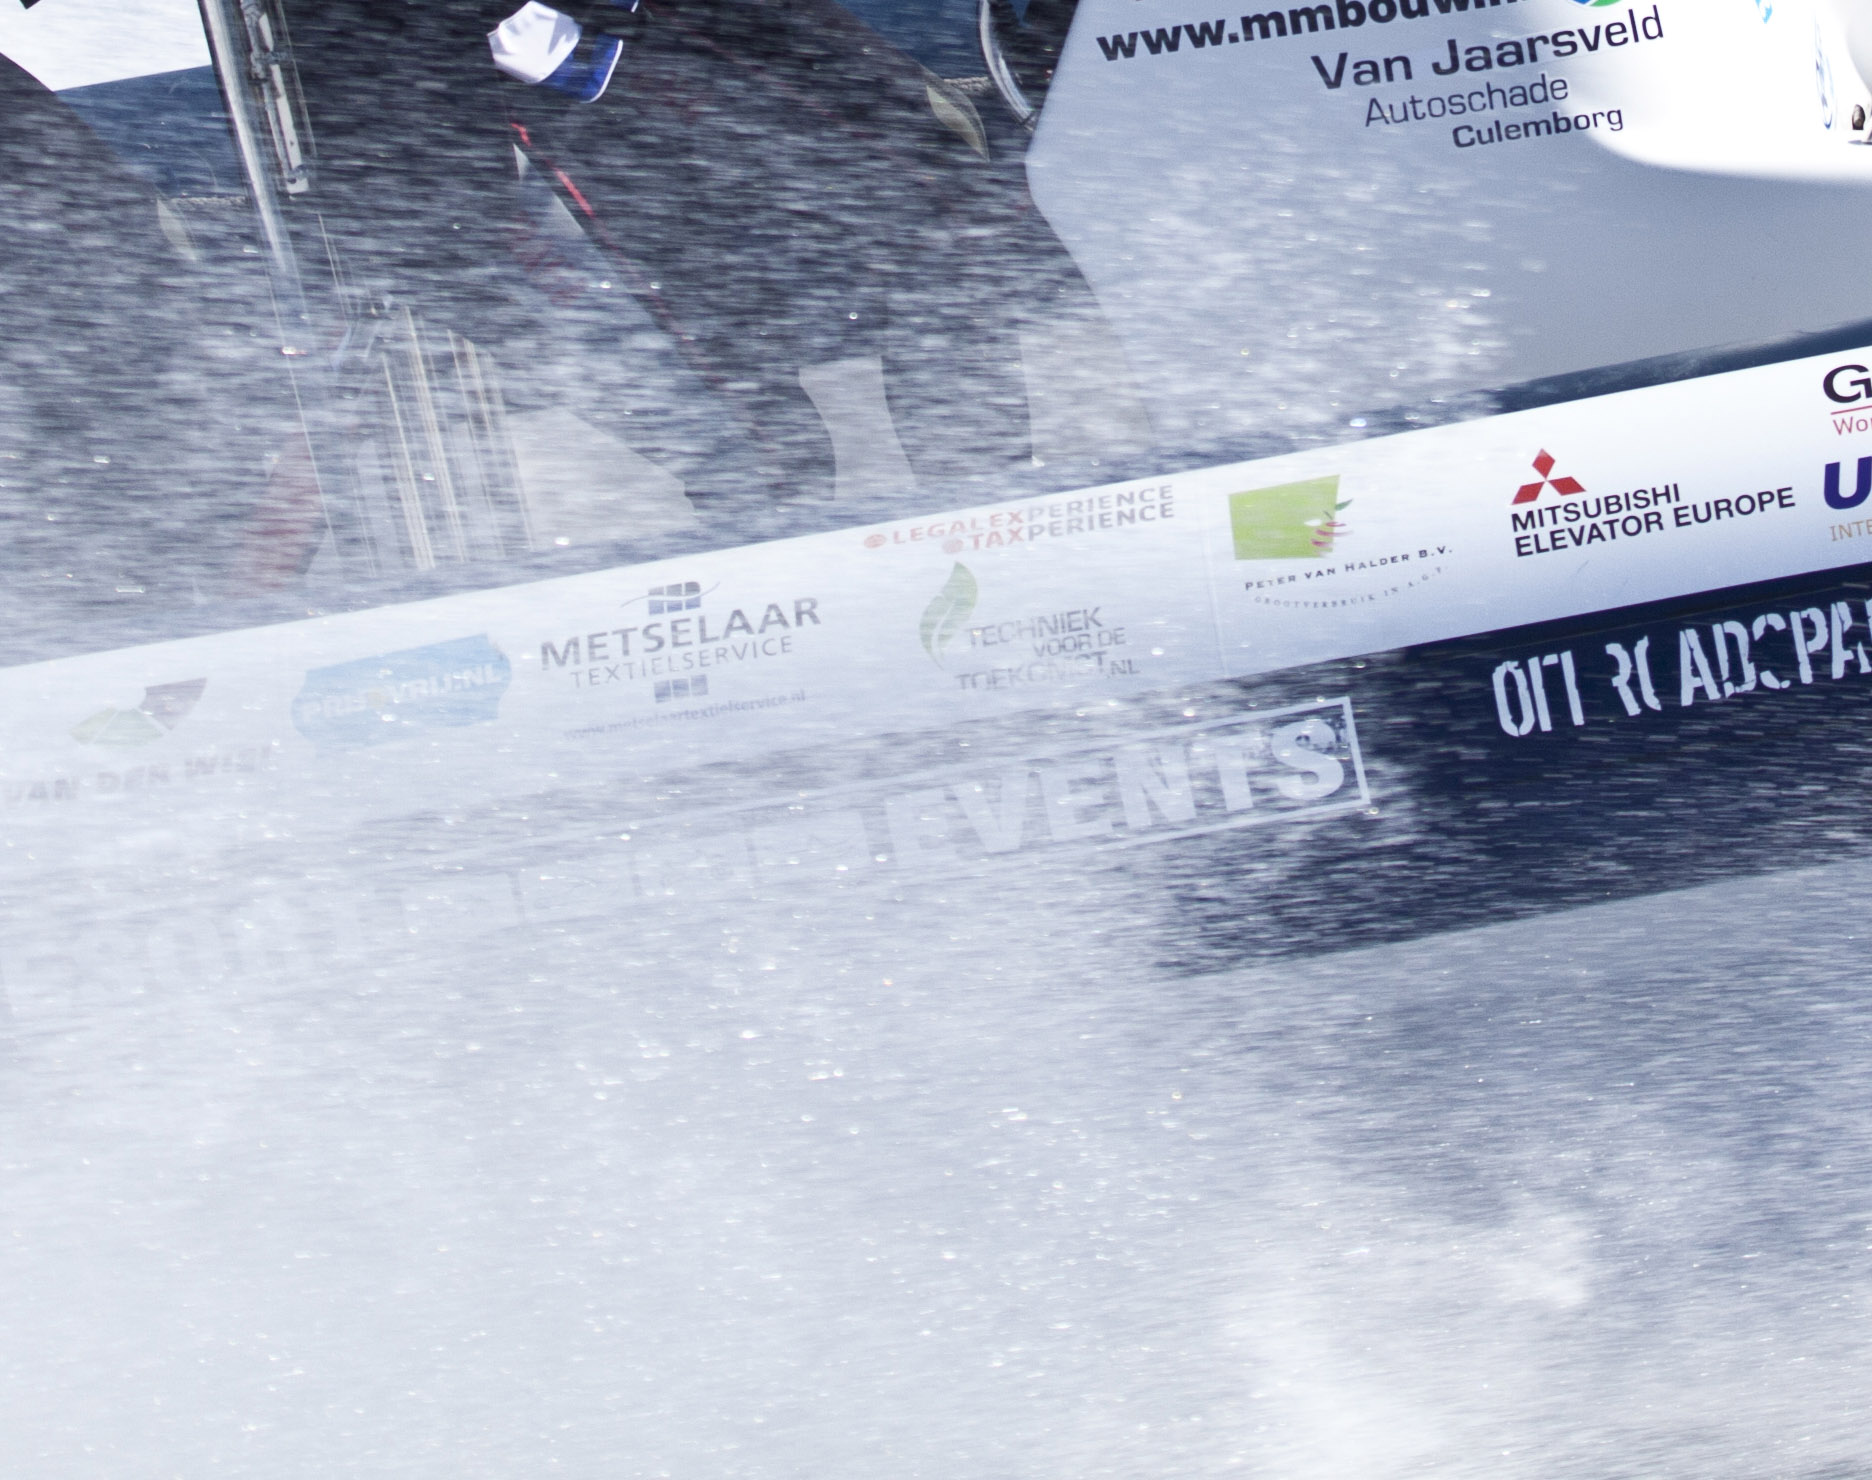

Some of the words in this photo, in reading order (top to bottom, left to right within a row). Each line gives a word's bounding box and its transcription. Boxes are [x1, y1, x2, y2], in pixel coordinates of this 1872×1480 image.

[1311, 50, 1413, 90] Van
[1430, 4, 1664, 77] Jaarsveld
[1364, 73, 1569, 128] Autoschade
[1452, 107, 1624, 149] Culemborg
[1511, 483, 1681, 533] MITSUBISHI
[1514, 511, 1666, 557] ELEVATOR
[1673, 486, 1796, 528] EUROPE
[1244, 574, 1296, 591] PETER
[1304, 567, 1336, 580] VAN
[1344, 554, 1410, 572] HALDER
[1418, 545, 1453, 559] B.V.
[539, 597, 822, 671] METSELAAR
[1097, 626, 1127, 648] DE
[569, 635, 794, 690] TEXTIELSERVICE
